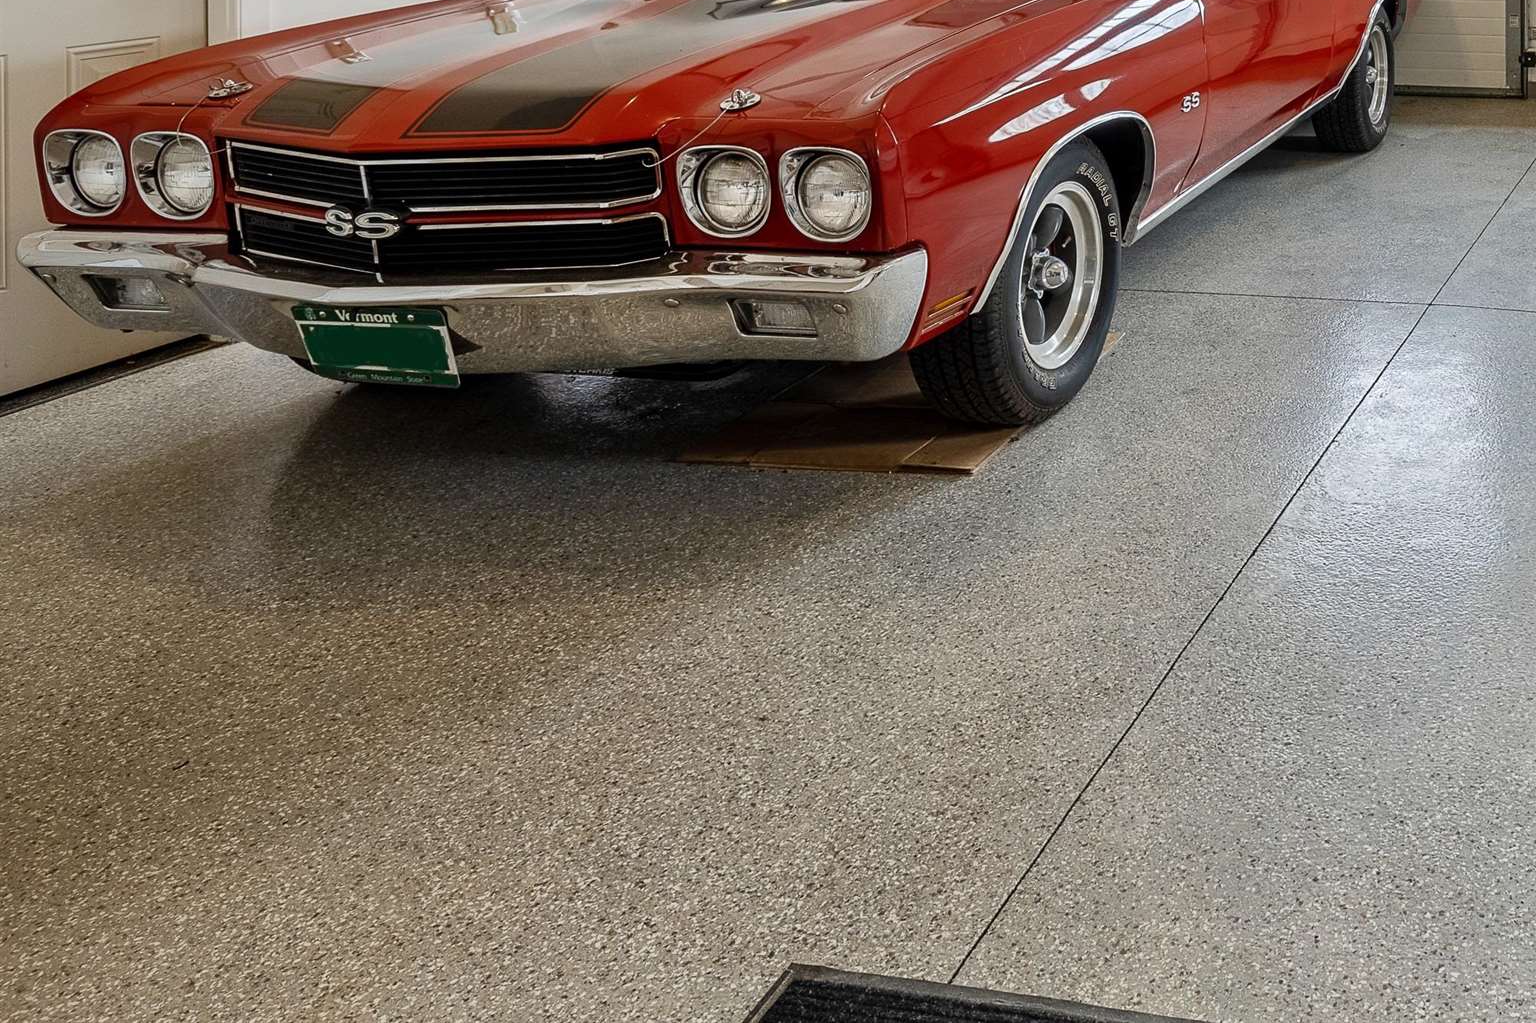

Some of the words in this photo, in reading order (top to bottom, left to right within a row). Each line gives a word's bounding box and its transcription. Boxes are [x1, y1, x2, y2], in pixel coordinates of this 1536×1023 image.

[1180, 91, 1200, 112] SS
[1076, 162, 1112, 206] RADIAL
[325, 208, 400, 239] SS
